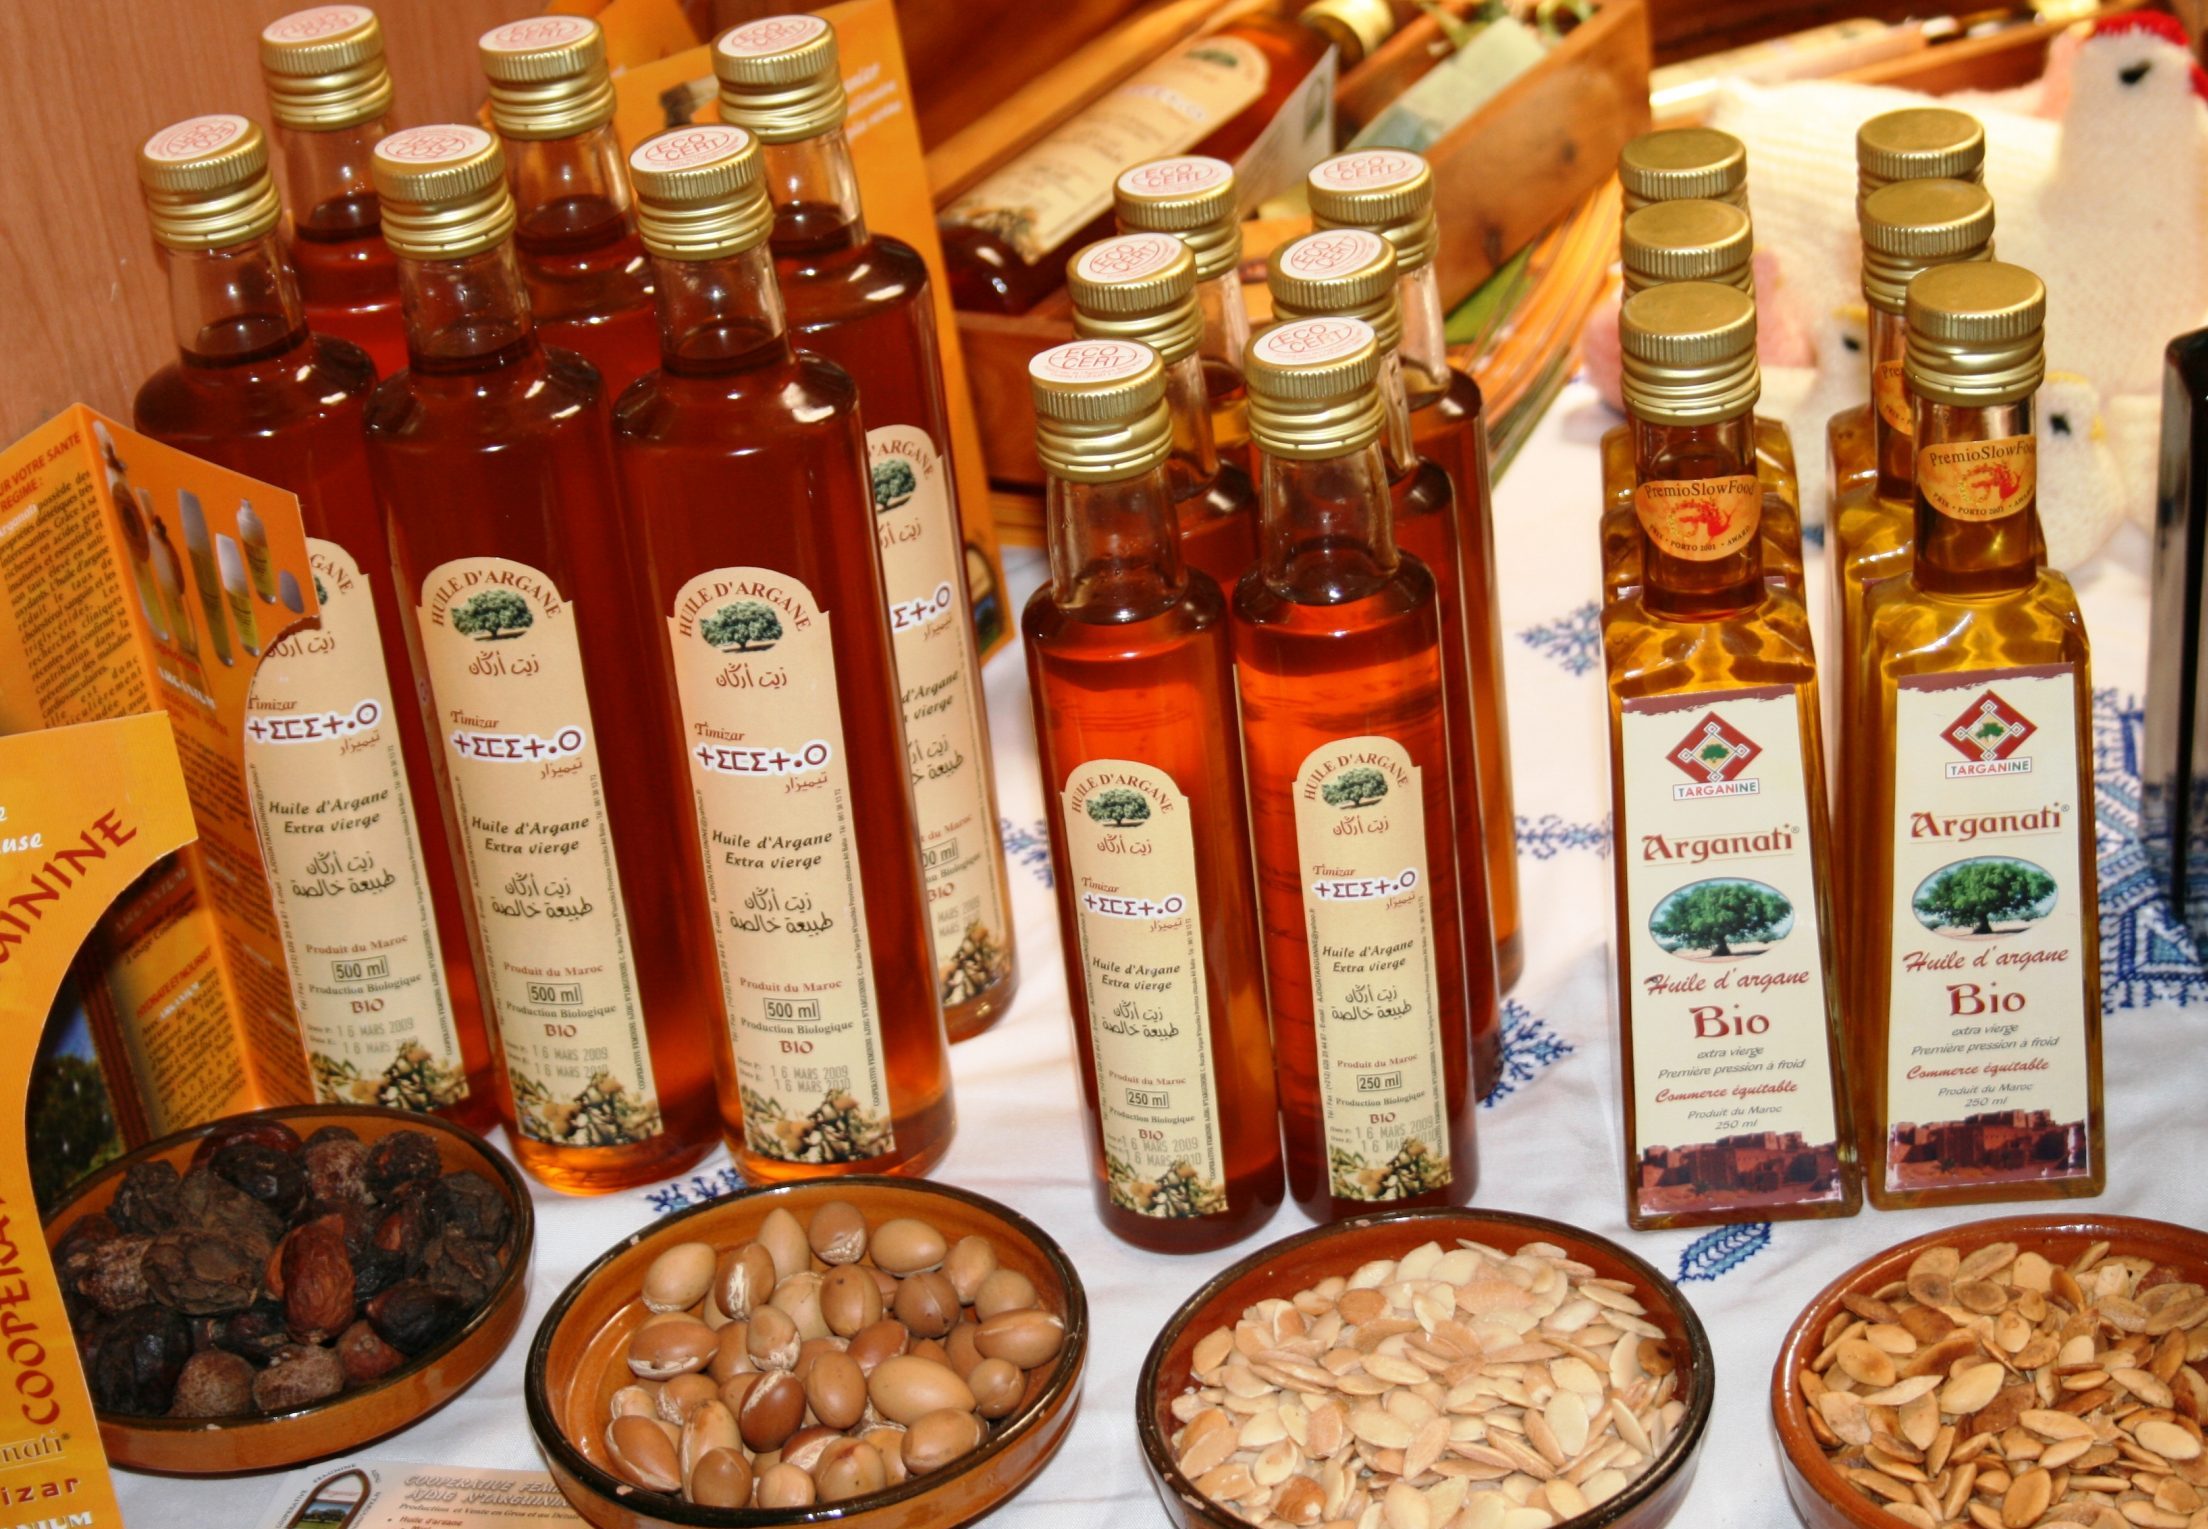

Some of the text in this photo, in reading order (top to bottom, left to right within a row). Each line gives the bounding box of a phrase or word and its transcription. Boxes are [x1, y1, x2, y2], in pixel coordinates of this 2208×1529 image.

[11, 431, 81, 485] VOTRE SANTE
[1670, 541, 1698, 551] PORTO
[431, 569, 562, 627] HUILE D'ARGANE
[679, 581, 812, 638] HUILE D'ARGANE
[914, 695, 954, 721] vierge
[450, 709, 499, 729] Timizar
[694, 722, 746, 742] Timizar
[1303, 752, 1410, 801] HUILE D'ARGANE
[1951, 760, 2030, 776] TARGANINE
[1071, 773, 1175, 815] HUILE D'ARGANE
[1678, 781, 1757, 799] TARGANINE
[269, 788, 390, 815] Huile d'Argane
[284, 813, 381, 835] Extra vierge
[471, 816, 590, 837] Huile d'Argane
[485, 838, 579, 855] Extra vierge
[712, 829, 833, 851] Huile d'Argane
[940, 842, 957, 860] ml
[725, 852, 822, 870] Extra vierge
[1312, 864, 1356, 877] Timizar
[1081, 876, 1119, 893] Timizar
[305, 934, 409, 955] Produit du Maroc
[1322, 939, 1414, 958] Huile d'Argane
[336, 962, 386, 979] 500 ml
[503, 962, 604, 977] Produit du Maroc
[1092, 956, 1181, 978] Huile d'Argane
[1332, 957, 1406, 973] Extra vierge
[1902, 950, 1965, 973] Huile
[739, 977, 843, 993] Produit du Maroc
[1101, 974, 1173, 992] Extra vierge
[1643, 973, 1707, 996] Huile
[531, 986, 580, 1002] 500 ml
[1946, 981, 2026, 1017] Bio
[350, 998, 385, 1015] BIO
[506, 999, 617, 1019] Production Biologique
[767, 1001, 817, 1018] 500 ml
[543, 1023, 577, 1037] BIO
[740, 1017, 854, 1035] Production Biologique
[1689, 1003, 1770, 1039] Bio
[1952, 1022, 2019, 1036] extra vierge
[778, 1040, 814, 1054] BIO
[1697, 1045, 1764, 1060] extra vierge
[1911, 1037, 2060, 1056] Première pression à froid
[1337, 1054, 1418, 1069] Produit du Maroc
[1658, 1058, 1806, 1080] Première pression à froid
[1906, 1057, 2050, 1081] Commerce équitable
[1108, 1070, 1187, 1085] Produit du Maroc
[1359, 1074, 1399, 1090] 250 ml
[1128, 1091, 1167, 1107] 250 ml
[1336, 1090, 1426, 1108] Production Biologique
[1654, 1079, 1800, 1104] Commerce équitable
[1938, 1083, 2034, 1097] Produit du Maroc
[1964, 1096, 2008, 1108] 250 ml
[1108, 1106, 1196, 1125] Production Biologique
[1369, 1112, 1396, 1124] BIO
[1687, 1105, 1783, 1120] Produit du Maroc
[1714, 1118, 1758, 1131] 250 ml
[1138, 1128, 1164, 1141] BIO
[404, 1475, 515, 1492] COOPERATIVE
